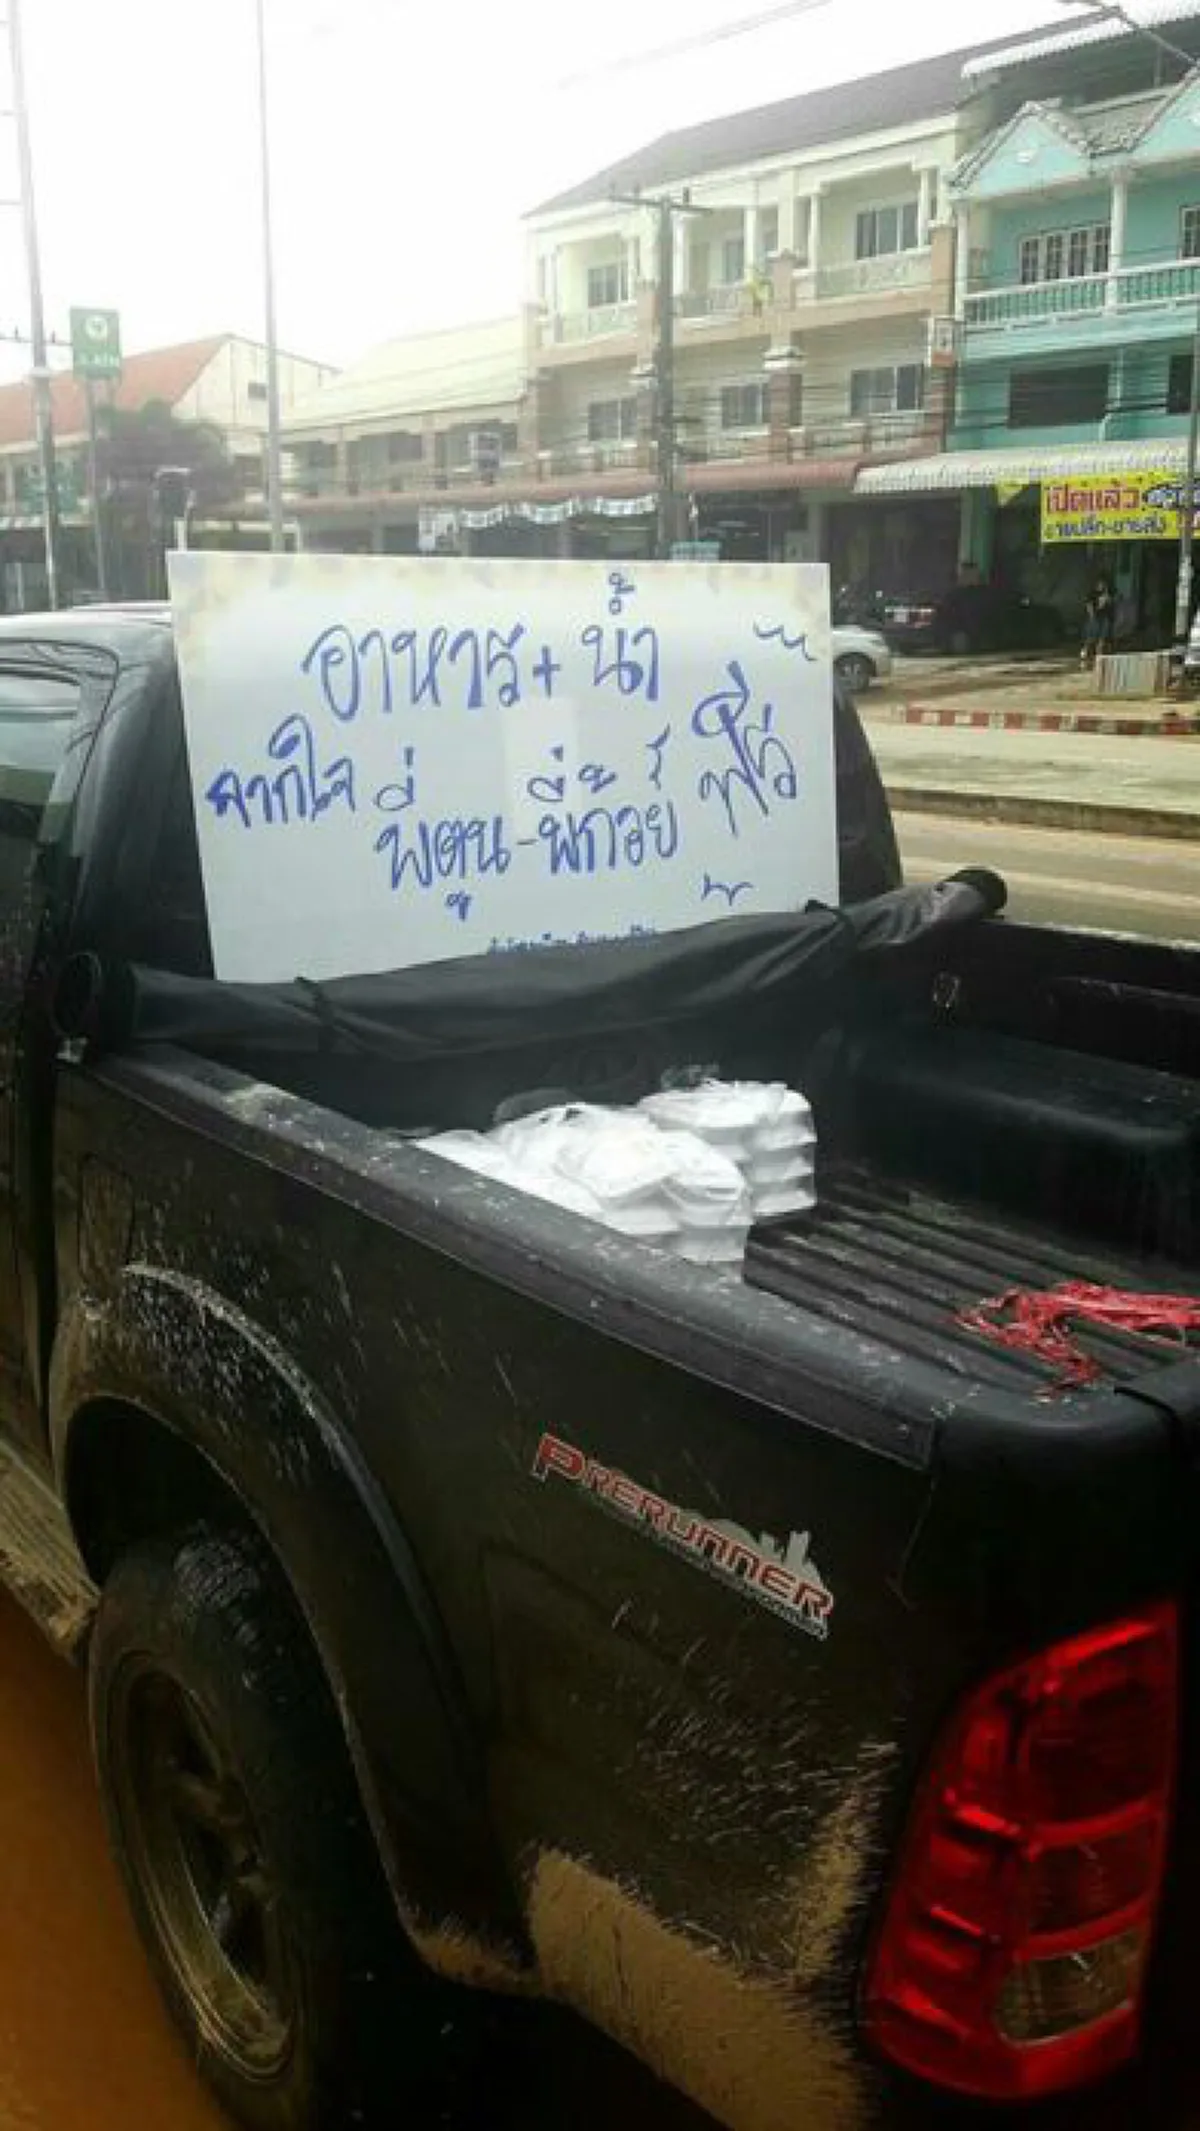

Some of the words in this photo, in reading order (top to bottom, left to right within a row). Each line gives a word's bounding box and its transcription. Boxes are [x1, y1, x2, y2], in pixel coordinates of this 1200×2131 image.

[1046, 483, 1141, 514] เปิดแล้ว
[205, 713, 356, 829] จากใจ
